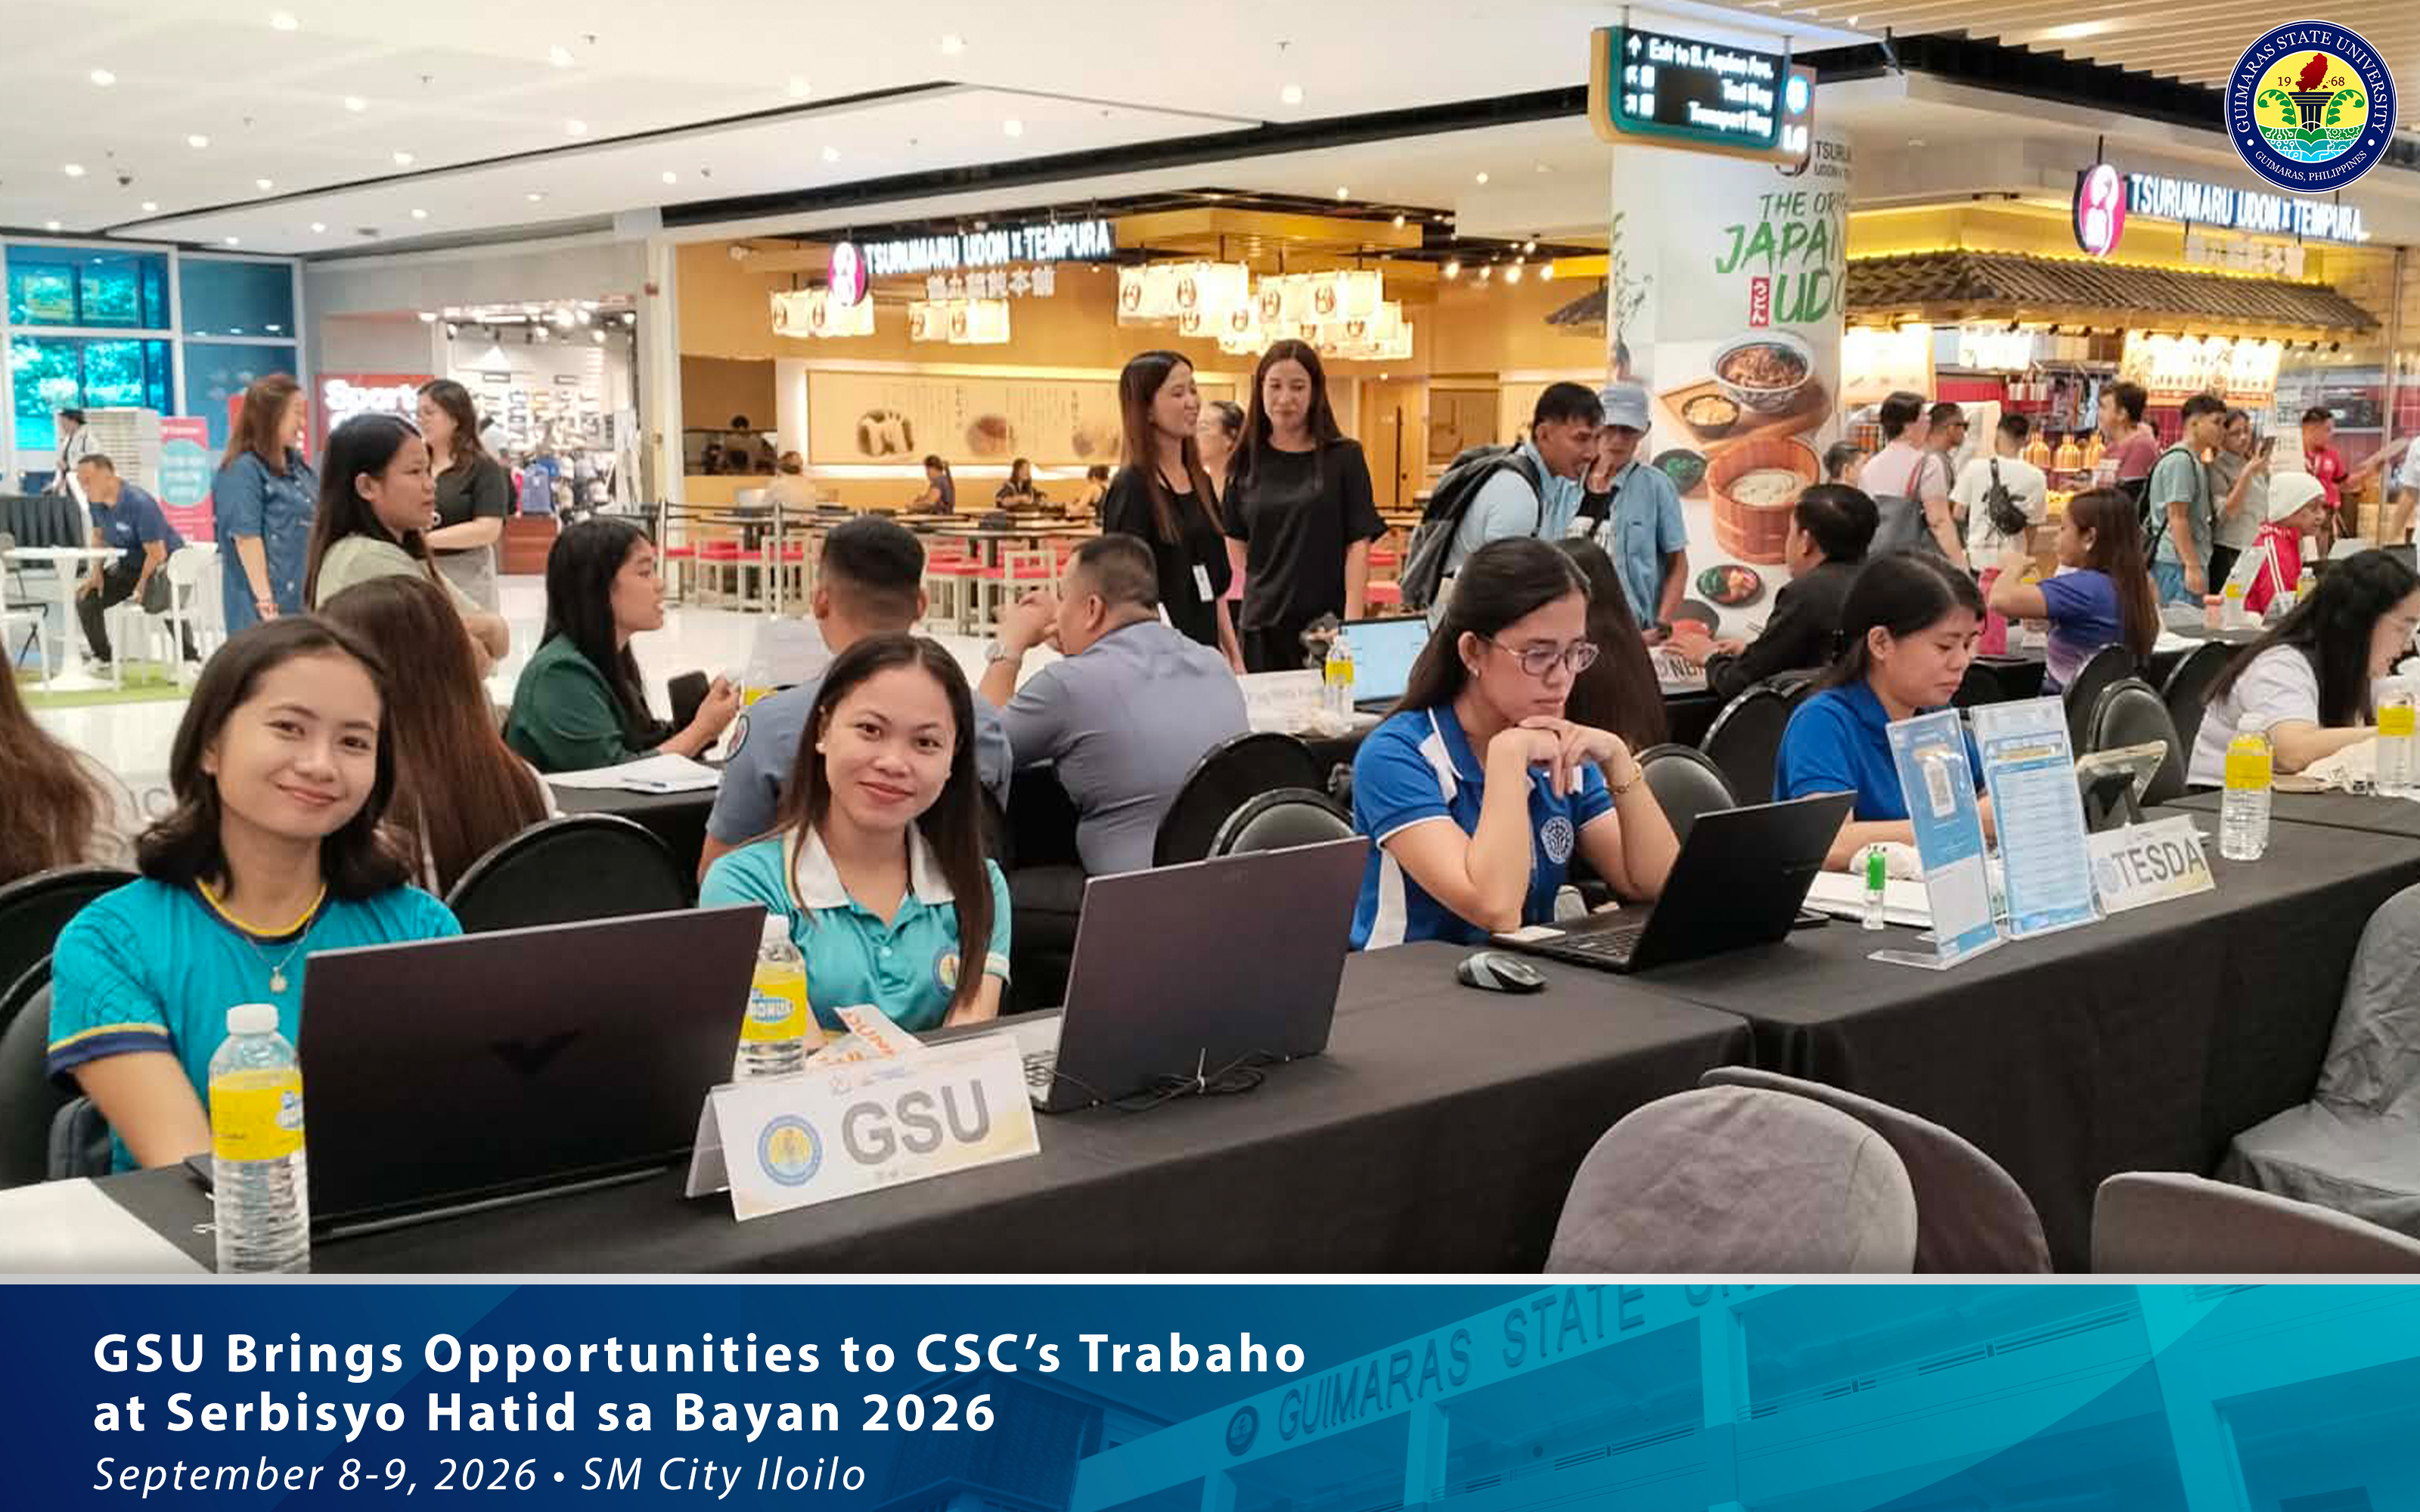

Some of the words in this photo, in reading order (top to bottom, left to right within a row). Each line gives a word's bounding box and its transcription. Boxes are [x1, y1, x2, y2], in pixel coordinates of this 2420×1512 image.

[1760, 192, 1808, 220] THE
[2131, 173, 2233, 225] TSURUMARU
[2237, 191, 2281, 231] UDON
[2293, 198, 2361, 241] TEMPURA
[864, 236, 959, 274] TSURUMARU
[963, 230, 1009, 265] UDON
[1025, 220, 1111, 260] TEMPURA
[2115, 839, 2206, 889] TESDA
[842, 1080, 990, 1165] GSU
